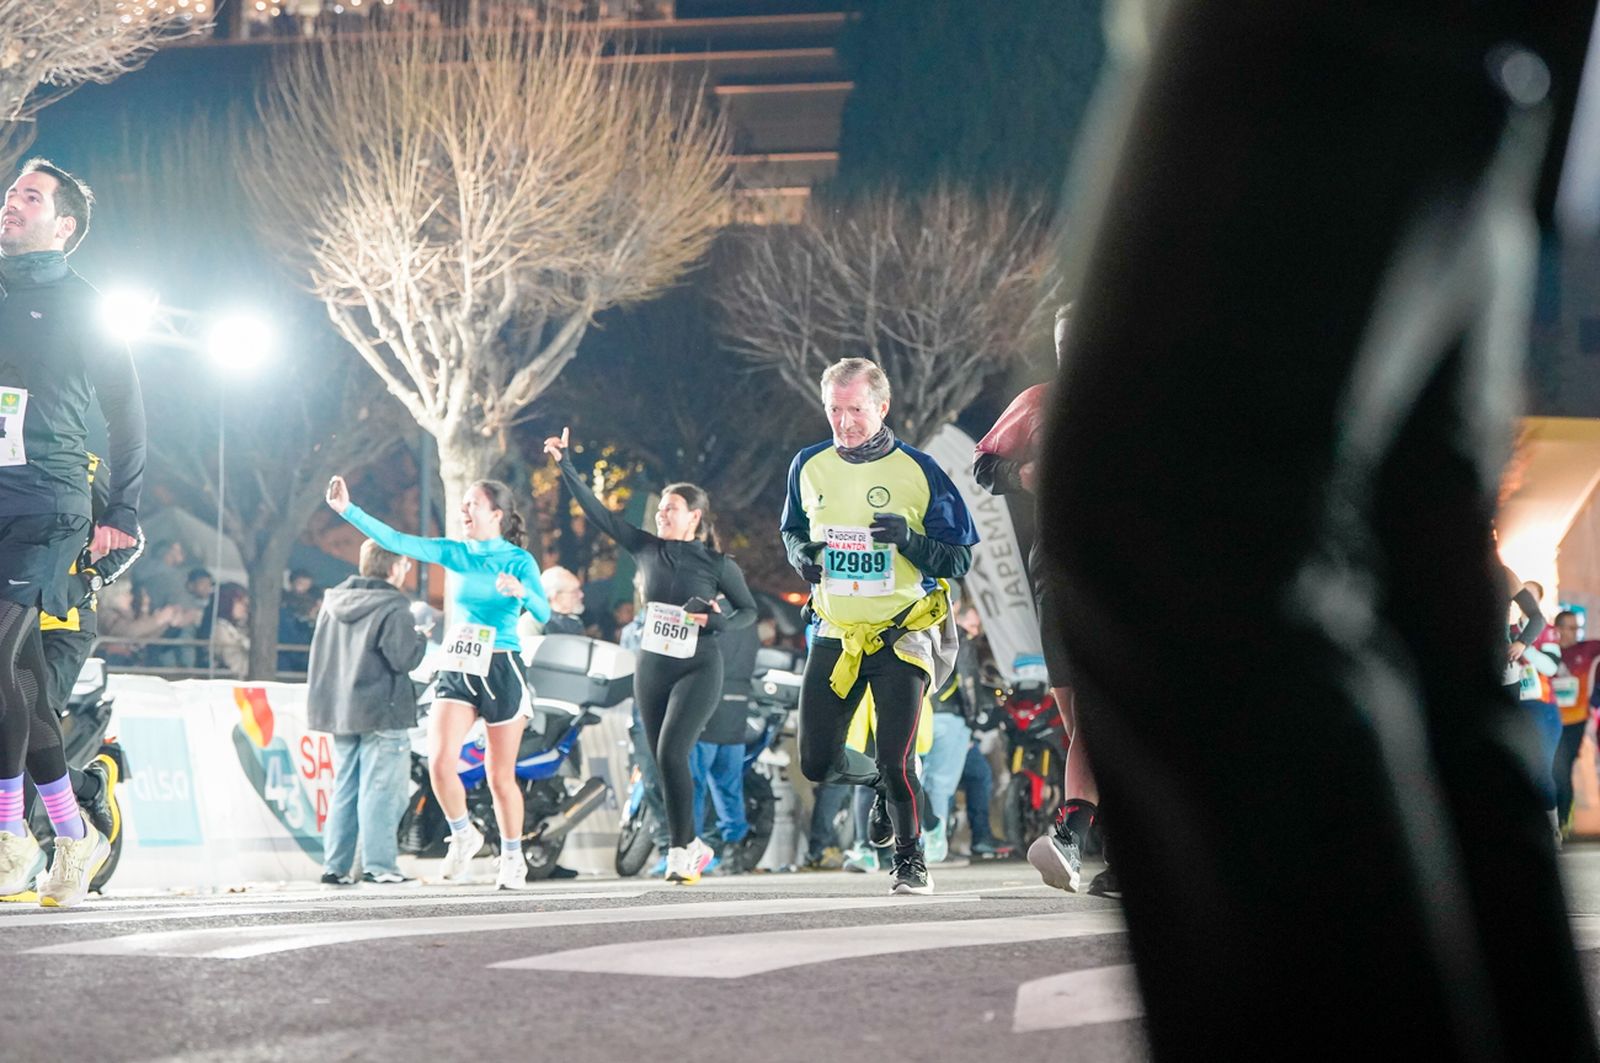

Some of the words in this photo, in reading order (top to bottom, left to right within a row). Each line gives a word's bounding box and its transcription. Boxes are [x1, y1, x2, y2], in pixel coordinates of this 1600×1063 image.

[964, 464, 1029, 611] JAPEMA
[828, 550, 886, 573] 12989
[653, 620, 689, 641] 6650
[300, 735, 335, 780] SA
[133, 764, 190, 801] alsa
